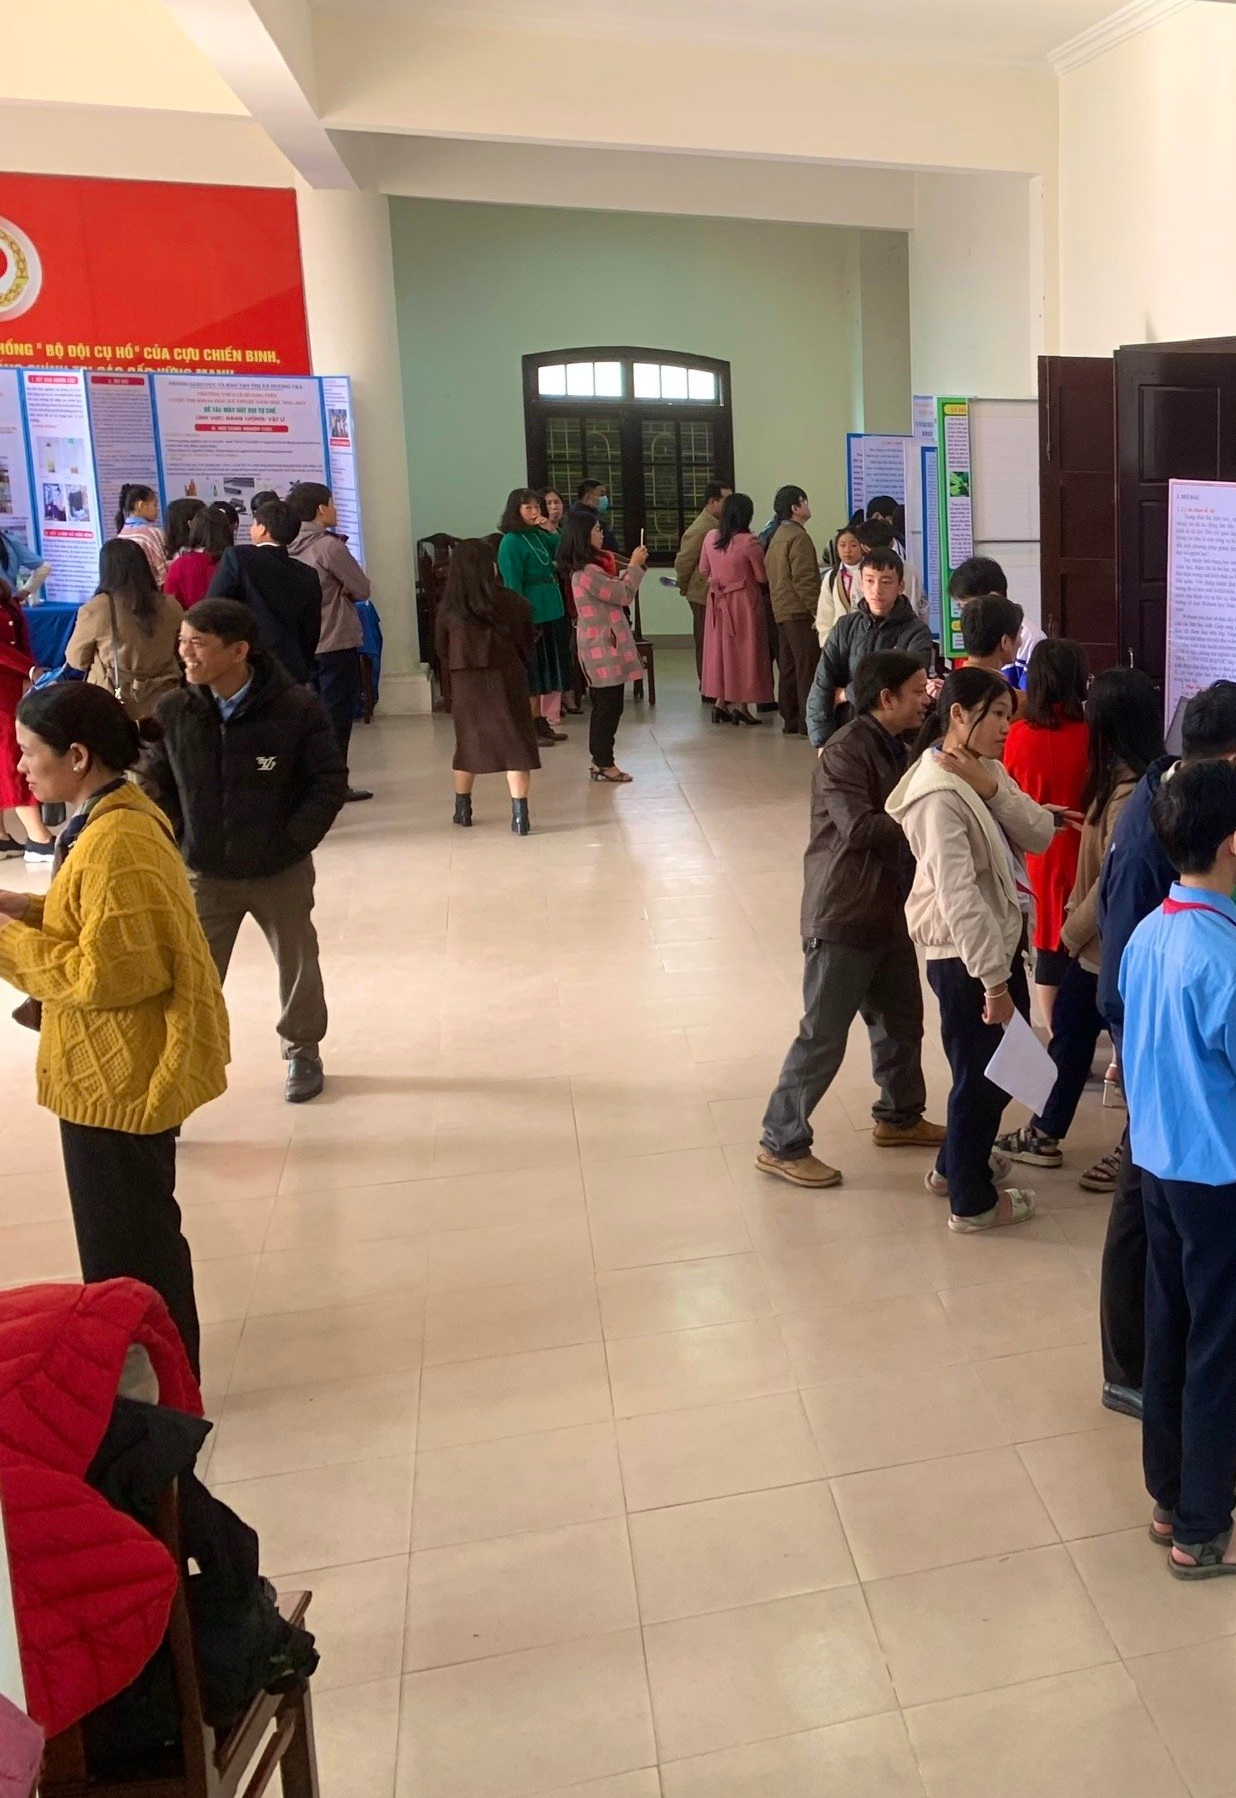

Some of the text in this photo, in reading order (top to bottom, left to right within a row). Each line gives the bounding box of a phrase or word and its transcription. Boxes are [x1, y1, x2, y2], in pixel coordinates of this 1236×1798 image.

[46, 342, 64, 359] BỘ
[68, 343, 90, 360] ĐỘI
[94, 346, 112, 361] CỤ
[144, 343, 170, 360] CỦA
[204, 346, 241, 362] CHIẾN
[245, 350, 280, 364] BINH,
